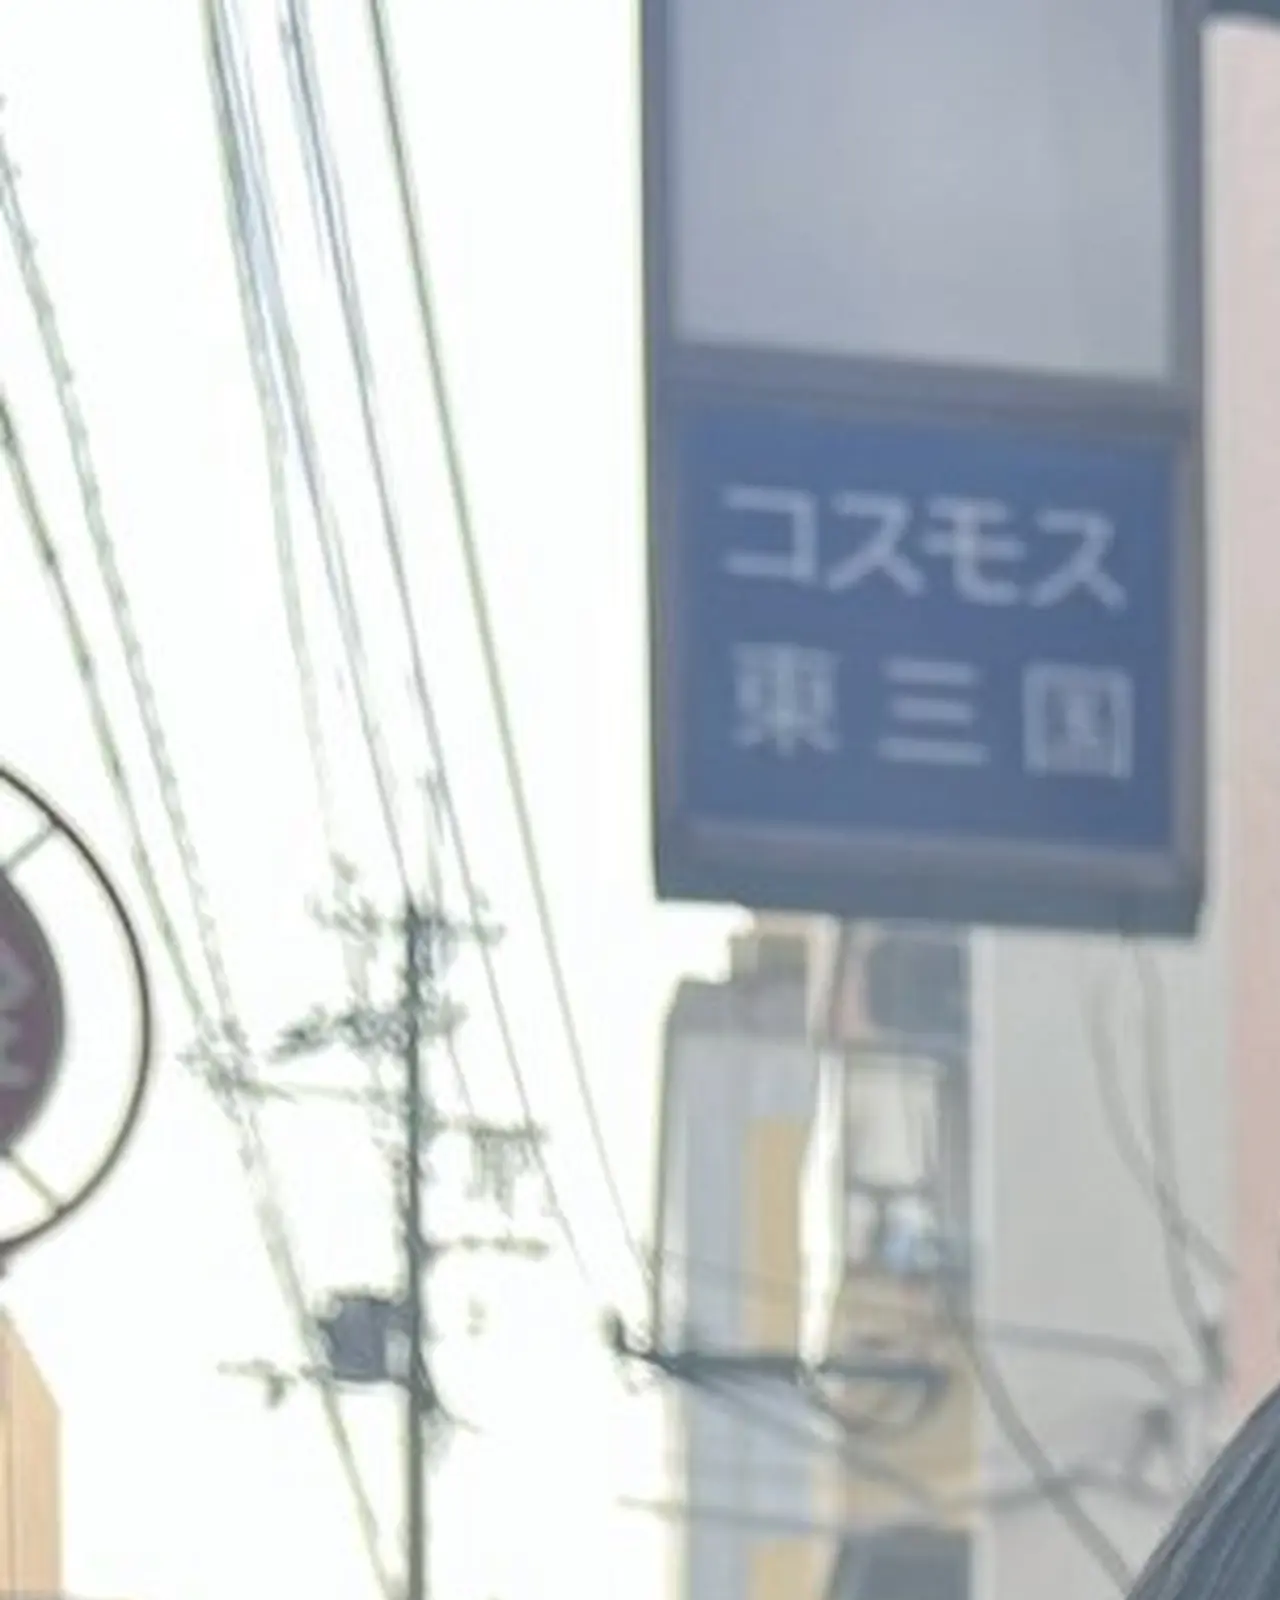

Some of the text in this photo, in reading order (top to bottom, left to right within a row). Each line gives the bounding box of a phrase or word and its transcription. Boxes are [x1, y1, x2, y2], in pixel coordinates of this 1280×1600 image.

[721, 486, 1127, 612] コスモス
[732, 642, 1134, 779] 東三国
